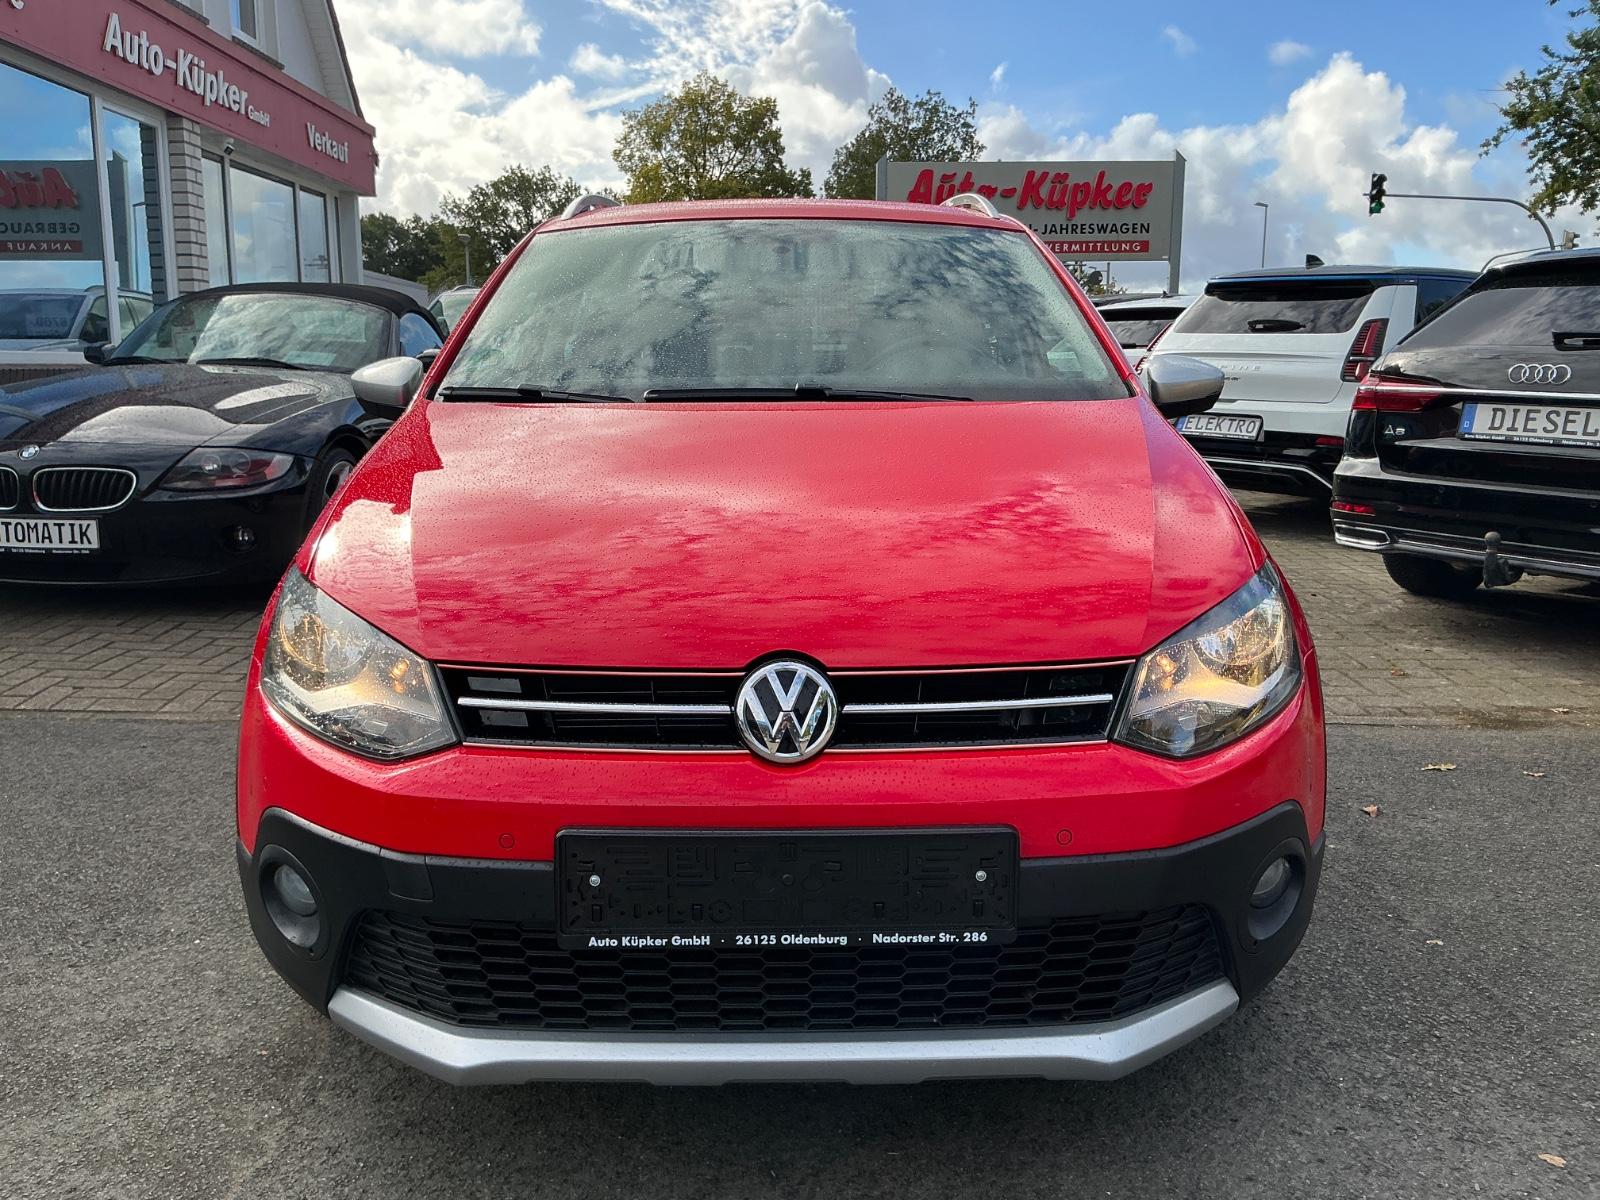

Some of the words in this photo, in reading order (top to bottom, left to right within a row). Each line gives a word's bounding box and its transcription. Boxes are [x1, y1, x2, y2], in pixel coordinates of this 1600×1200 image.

[103, 12, 248, 115] Auto-Küpker
[247, 105, 270, 127] GmbH
[305, 121, 349, 164] Verkauf
[1184, 416, 1257, 434] ELEKTRO
[1488, 407, 1600, 437] DIESEL
[0, 521, 92, 545] TOMATIK
[588, 936, 618, 947] Auto
[621, 935, 668, 948] Küpker
[671, 935, 711, 946] GmbH
[736, 934, 777, 945] 26125
[780, 933, 848, 946] Oldenburg
[872, 933, 936, 944] Nadorster
[938, 932, 961, 943] Str.
[963, 931, 989, 942] 286
